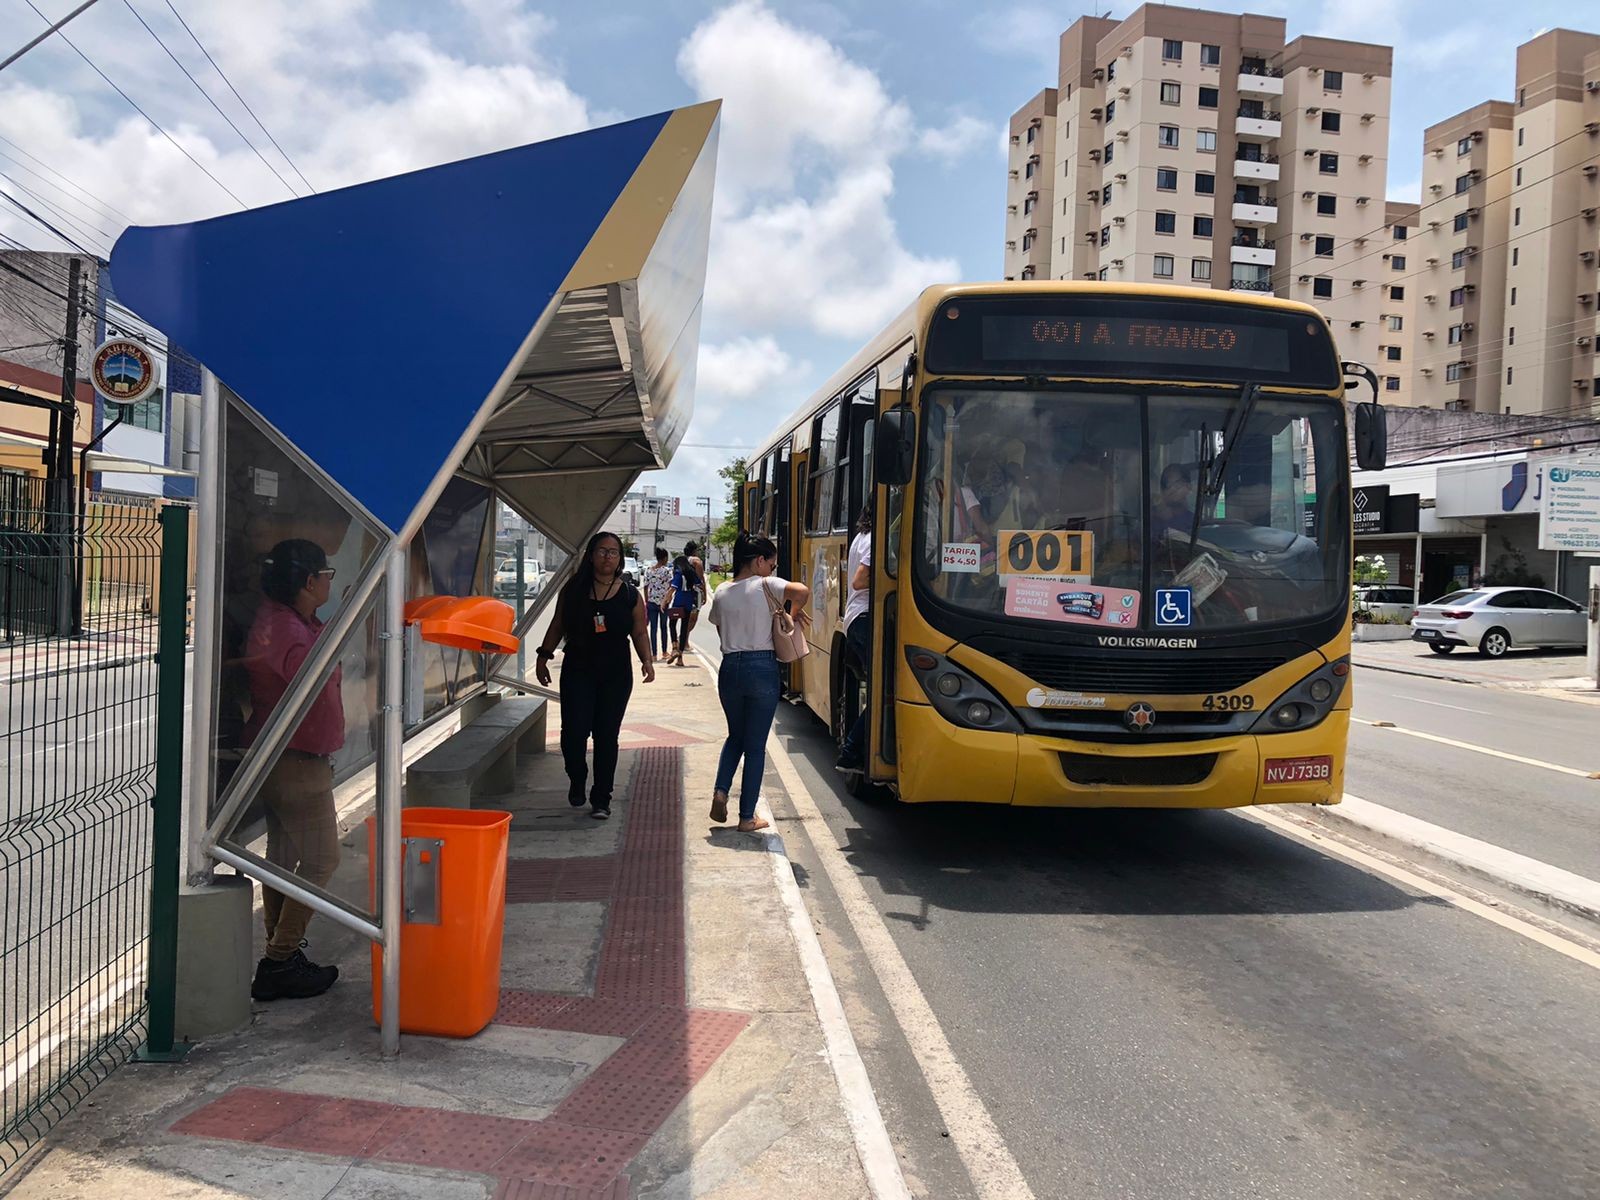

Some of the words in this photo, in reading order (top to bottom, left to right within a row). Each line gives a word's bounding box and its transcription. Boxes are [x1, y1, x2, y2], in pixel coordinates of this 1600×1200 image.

[1032, 320, 1082, 344] 001
[1127, 324, 1237, 351] FRANCO
[105, 344, 141, 358] RHEMA
[1363, 511, 1380, 521] STUDIO
[944, 546, 977, 556] TARIFA
[1008, 532, 1082, 571] 001
[943, 556, 955, 564] R$
[957, 558, 977, 566] 4,50
[1015, 597, 1049, 607] CARTÃO
[1098, 636, 1197, 648] VOLKSWAGEN
[1202, 695, 1254, 710] 4309
